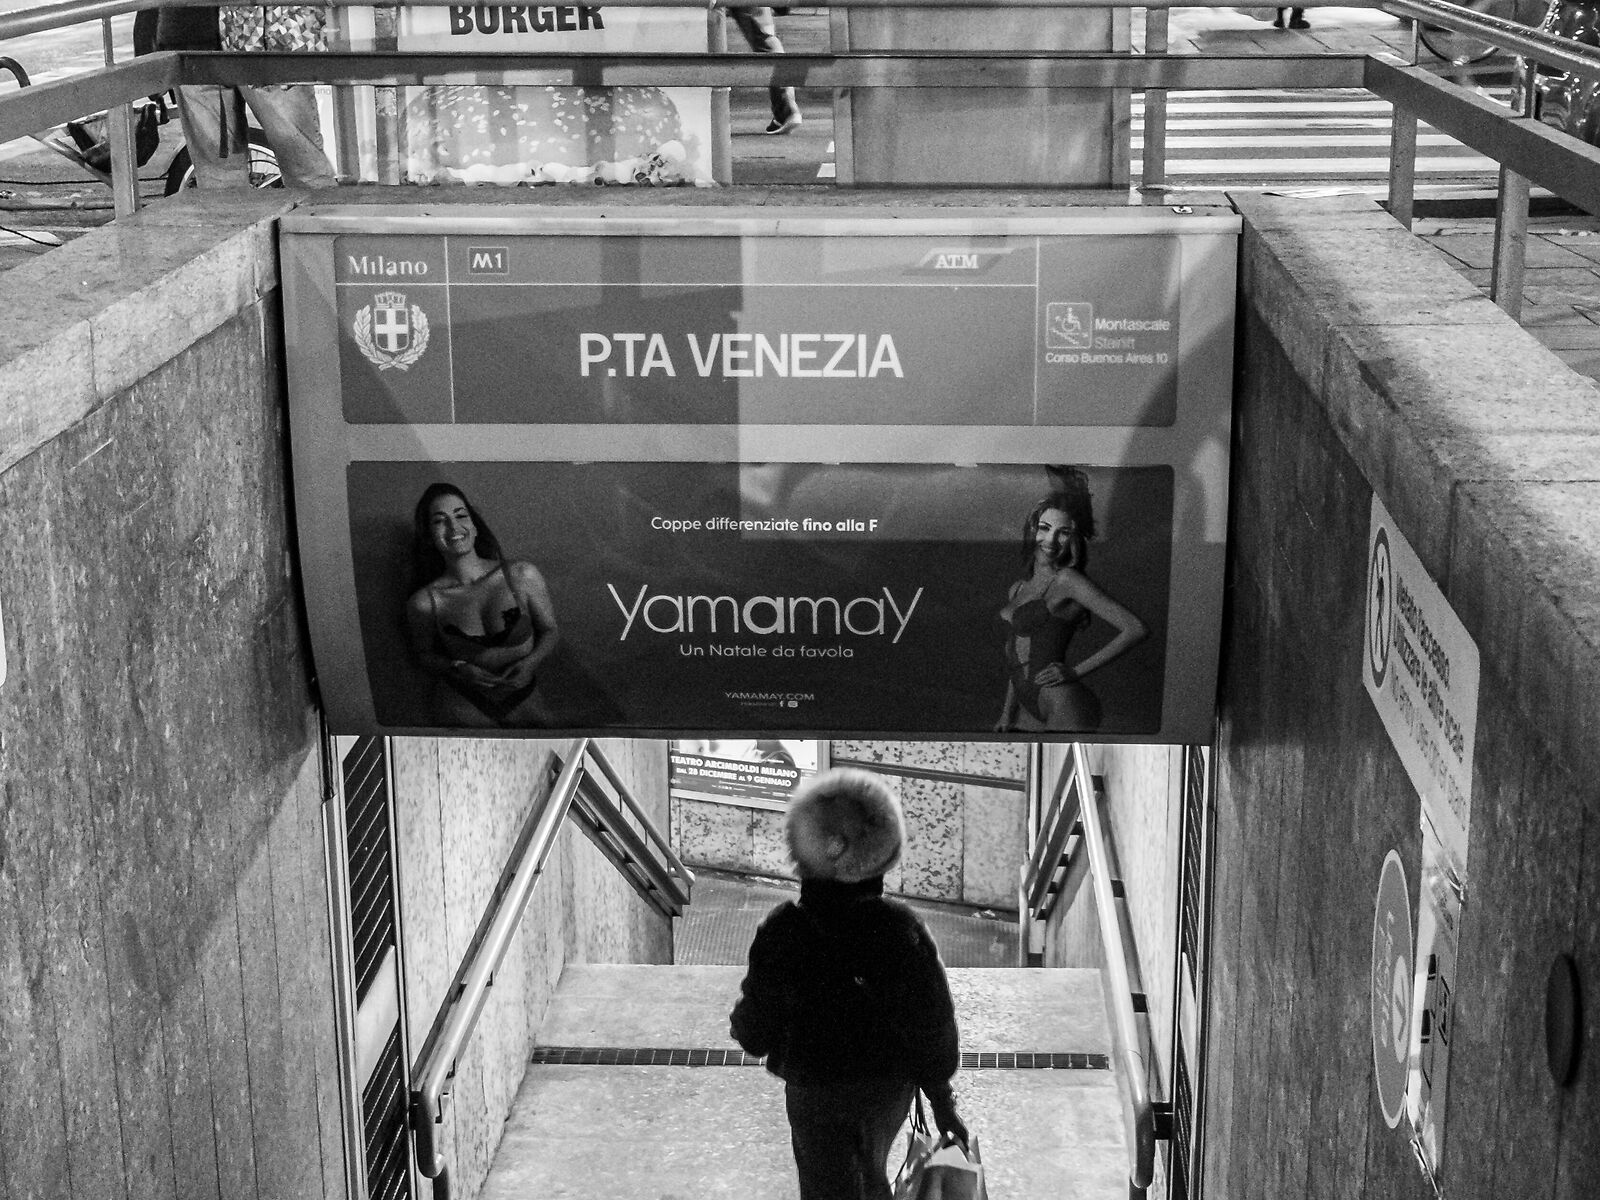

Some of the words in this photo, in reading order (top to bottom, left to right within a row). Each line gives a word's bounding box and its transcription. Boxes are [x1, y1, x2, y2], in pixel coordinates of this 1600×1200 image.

[451, 6, 605, 35] BURGER
[349, 256, 428, 275] Milano
[472, 253, 502, 269] M1
[934, 254, 979, 269] ATM
[1095, 318, 1170, 331] Montascale
[580, 333, 676, 377] P.TA
[687, 333, 904, 378] VENEZIA
[1045, 352, 1080, 363] Corso
[1081, 352, 1123, 363] Buenos
[1125, 352, 1153, 364] Aires
[1156, 352, 1168, 364] 10
[651, 516, 701, 533] Coppe
[705, 517, 799, 531] differenziate
[802, 517, 832, 532] fino
[836, 518, 865, 532] alla
[869, 519, 878, 532] F
[680, 644, 704, 657] Un
[710, 644, 767, 658] Natale
[772, 645, 795, 658] da
[800, 645, 854, 659] favola
[725, 691, 815, 701] YAMAMAY.COM
[671, 755, 703, 767] TEATRO
[705, 760, 760, 774] ARCIMBOLDI
[761, 767, 798, 779] MILANO
[688, 767, 698, 776] 28
[700, 768, 738, 780] DICEMBRE
[754, 776, 792, 787] GENNAIO
